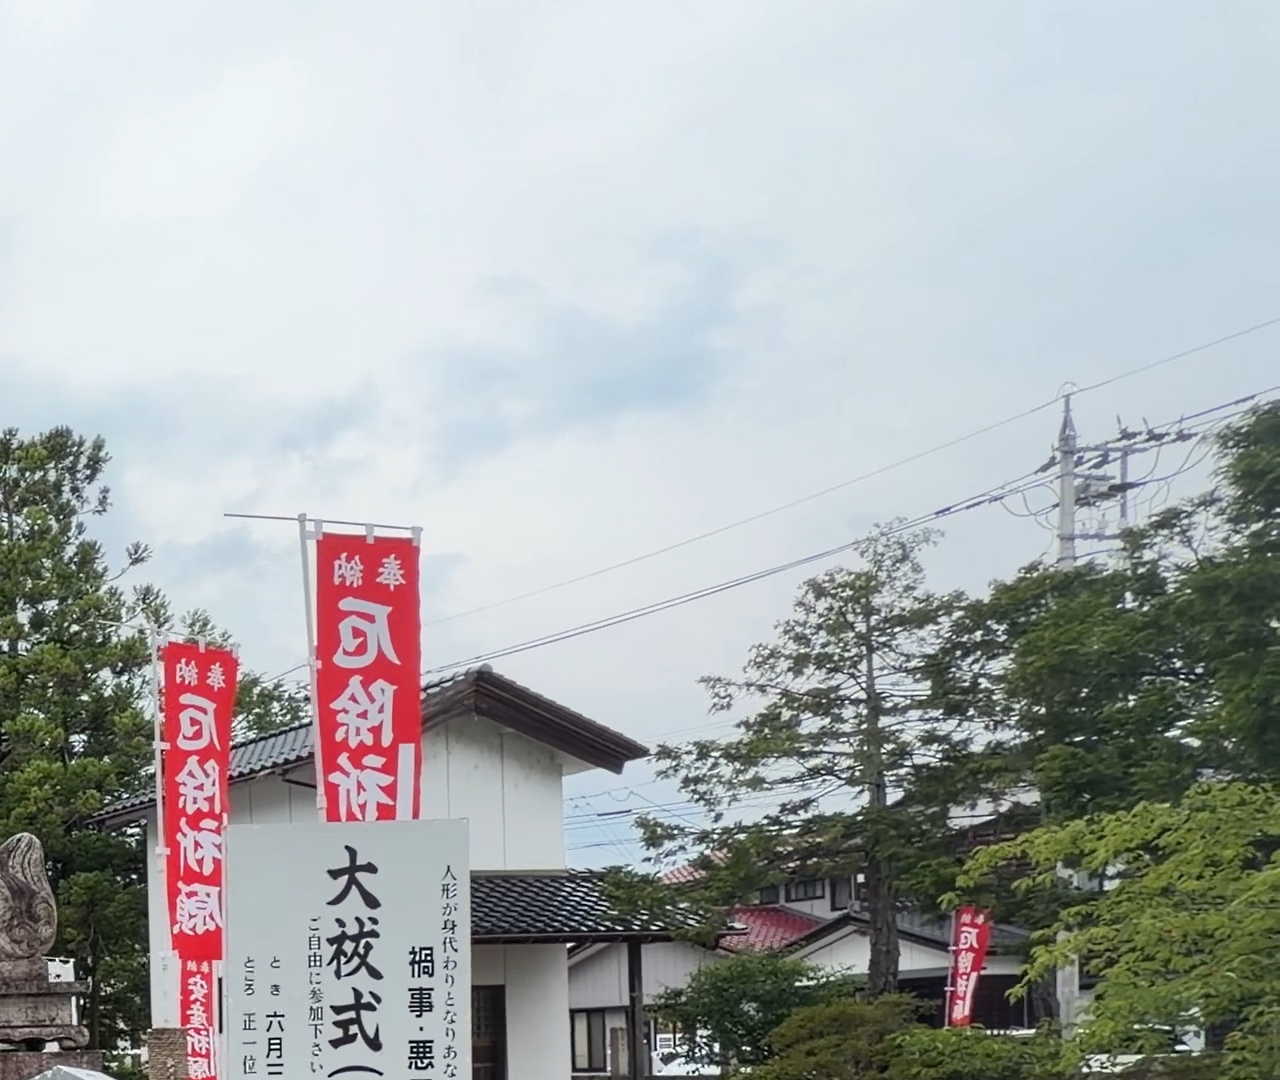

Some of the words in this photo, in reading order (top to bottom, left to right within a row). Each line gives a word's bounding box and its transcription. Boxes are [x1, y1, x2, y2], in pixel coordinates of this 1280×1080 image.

[243, 957, 255, 996] ところ
[308, 916, 324, 1073] ご自由に参加下さい
